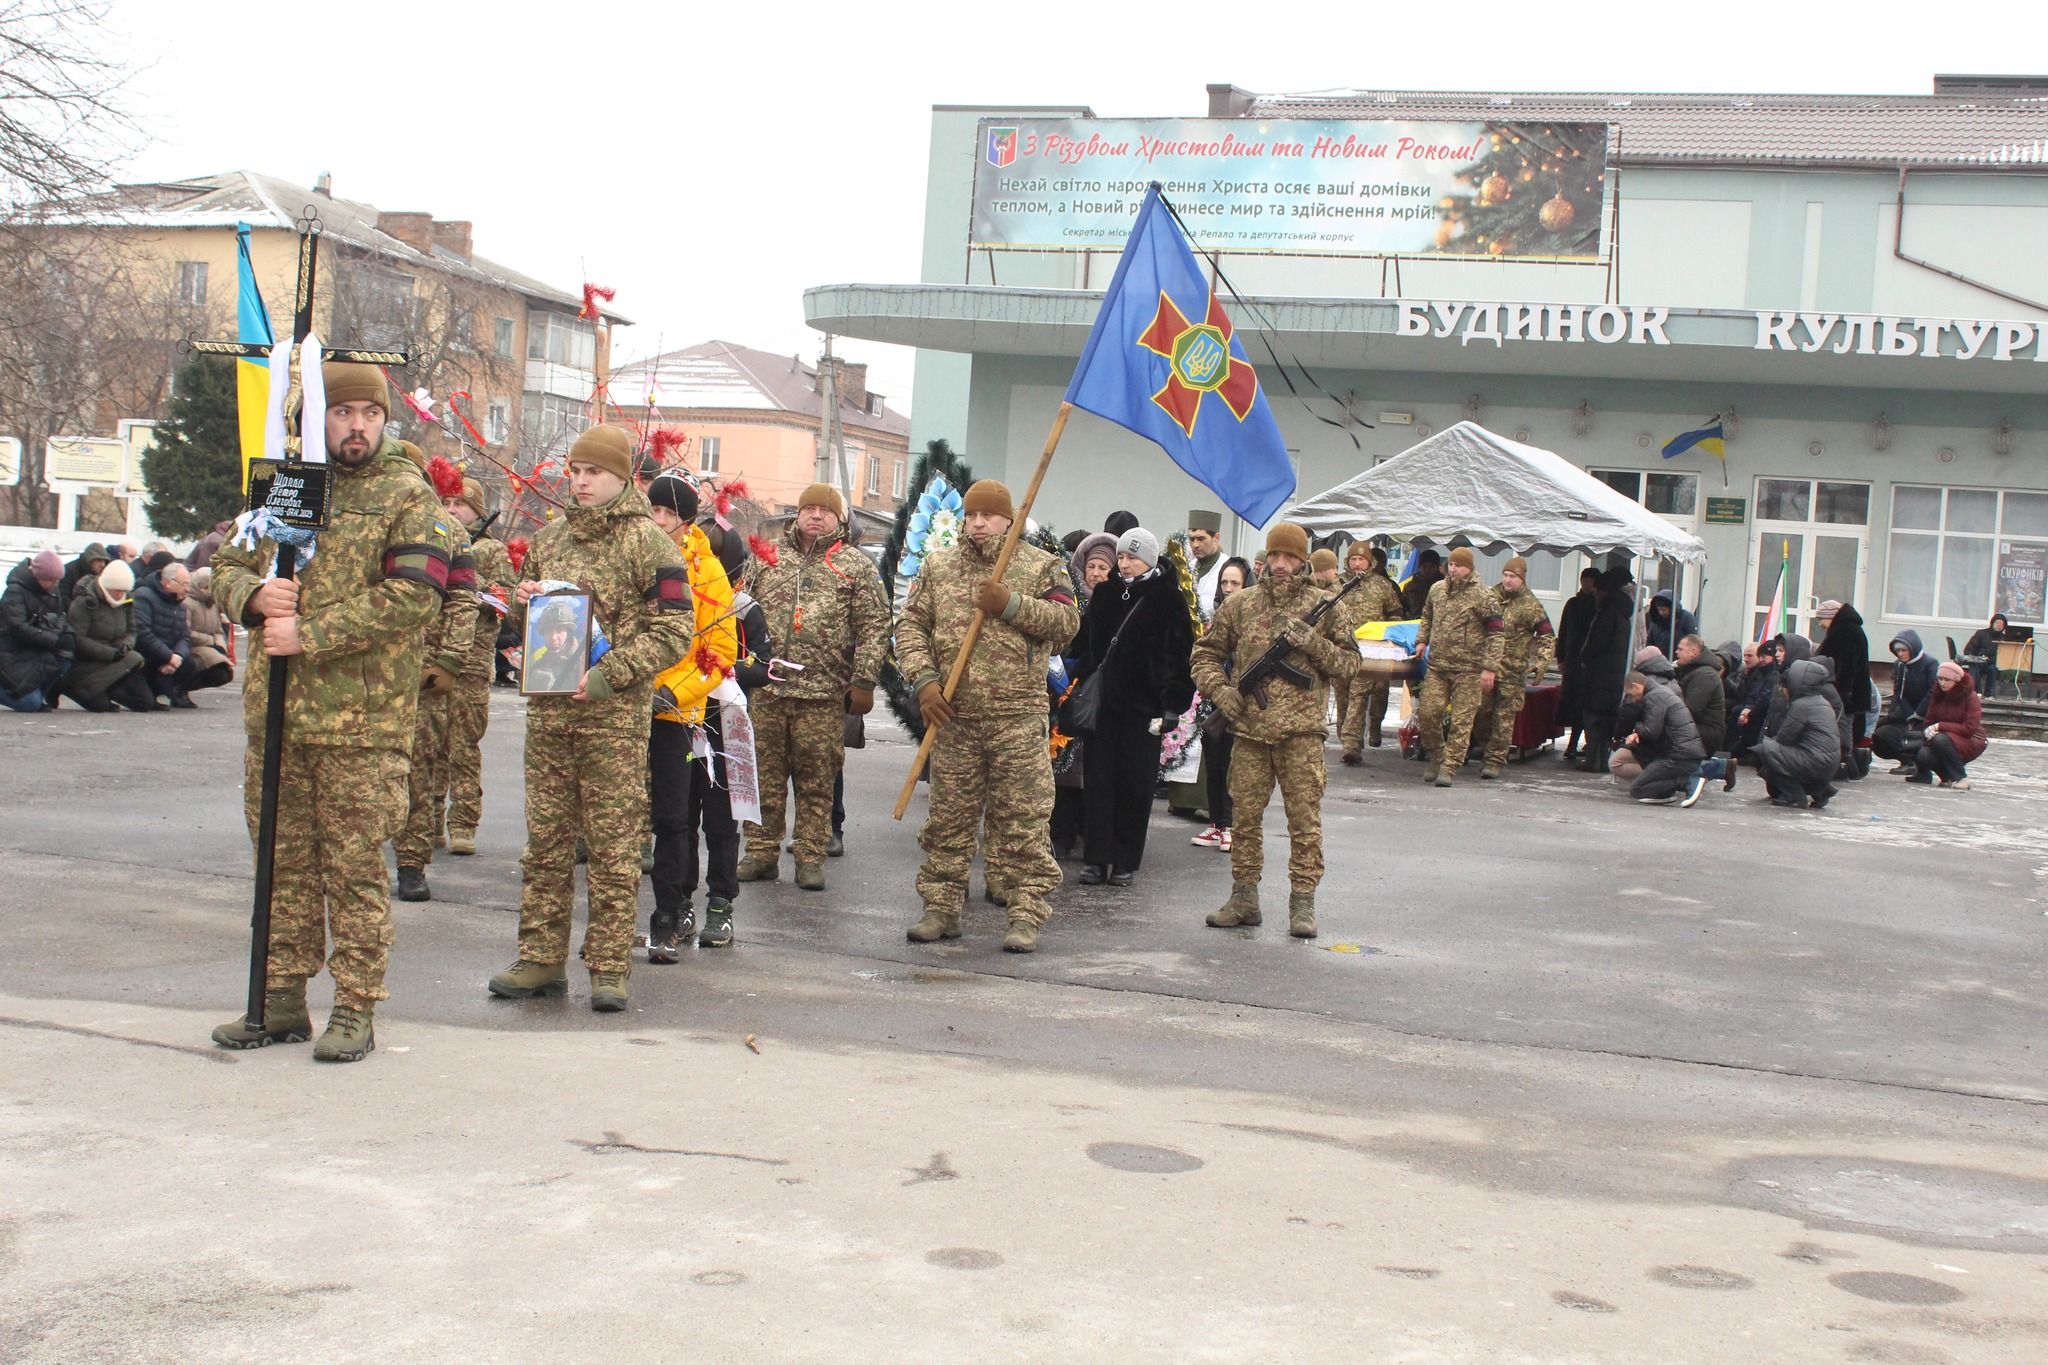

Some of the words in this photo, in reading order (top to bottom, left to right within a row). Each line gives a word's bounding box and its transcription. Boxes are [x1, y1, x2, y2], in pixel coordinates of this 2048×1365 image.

[1023, 135, 1038, 156] З
[1043, 132, 1129, 164] Різдвом
[1135, 133, 1264, 164] Христовим
[1271, 144, 1303, 158] та
[1311, 135, 1387, 160] Новим
[1395, 136, 1484, 162] Роком!
[1000, 177, 1047, 192] Нехай
[1053, 179, 1101, 193] світло
[1212, 179, 1268, 195] Христа
[1274, 182, 1311, 195] осяє
[1317, 181, 1355, 196] ваші
[1360, 182, 1431, 199] домівки
[992, 202, 1053, 216] теплом,
[1057, 203, 1066, 214] а
[1072, 199, 1124, 214] Новий
[1230, 205, 1263, 217] мир
[1269, 204, 1286, 215] та
[1291, 201, 1384, 219] здійснення
[1391, 204, 1436, 221] мрій!
[1062, 227, 1105, 237] Секретар
[1250, 231, 1317, 242] депутатський
[1320, 232, 1354, 243] корпус
[1396, 300, 1670, 347] БУДИНОК
